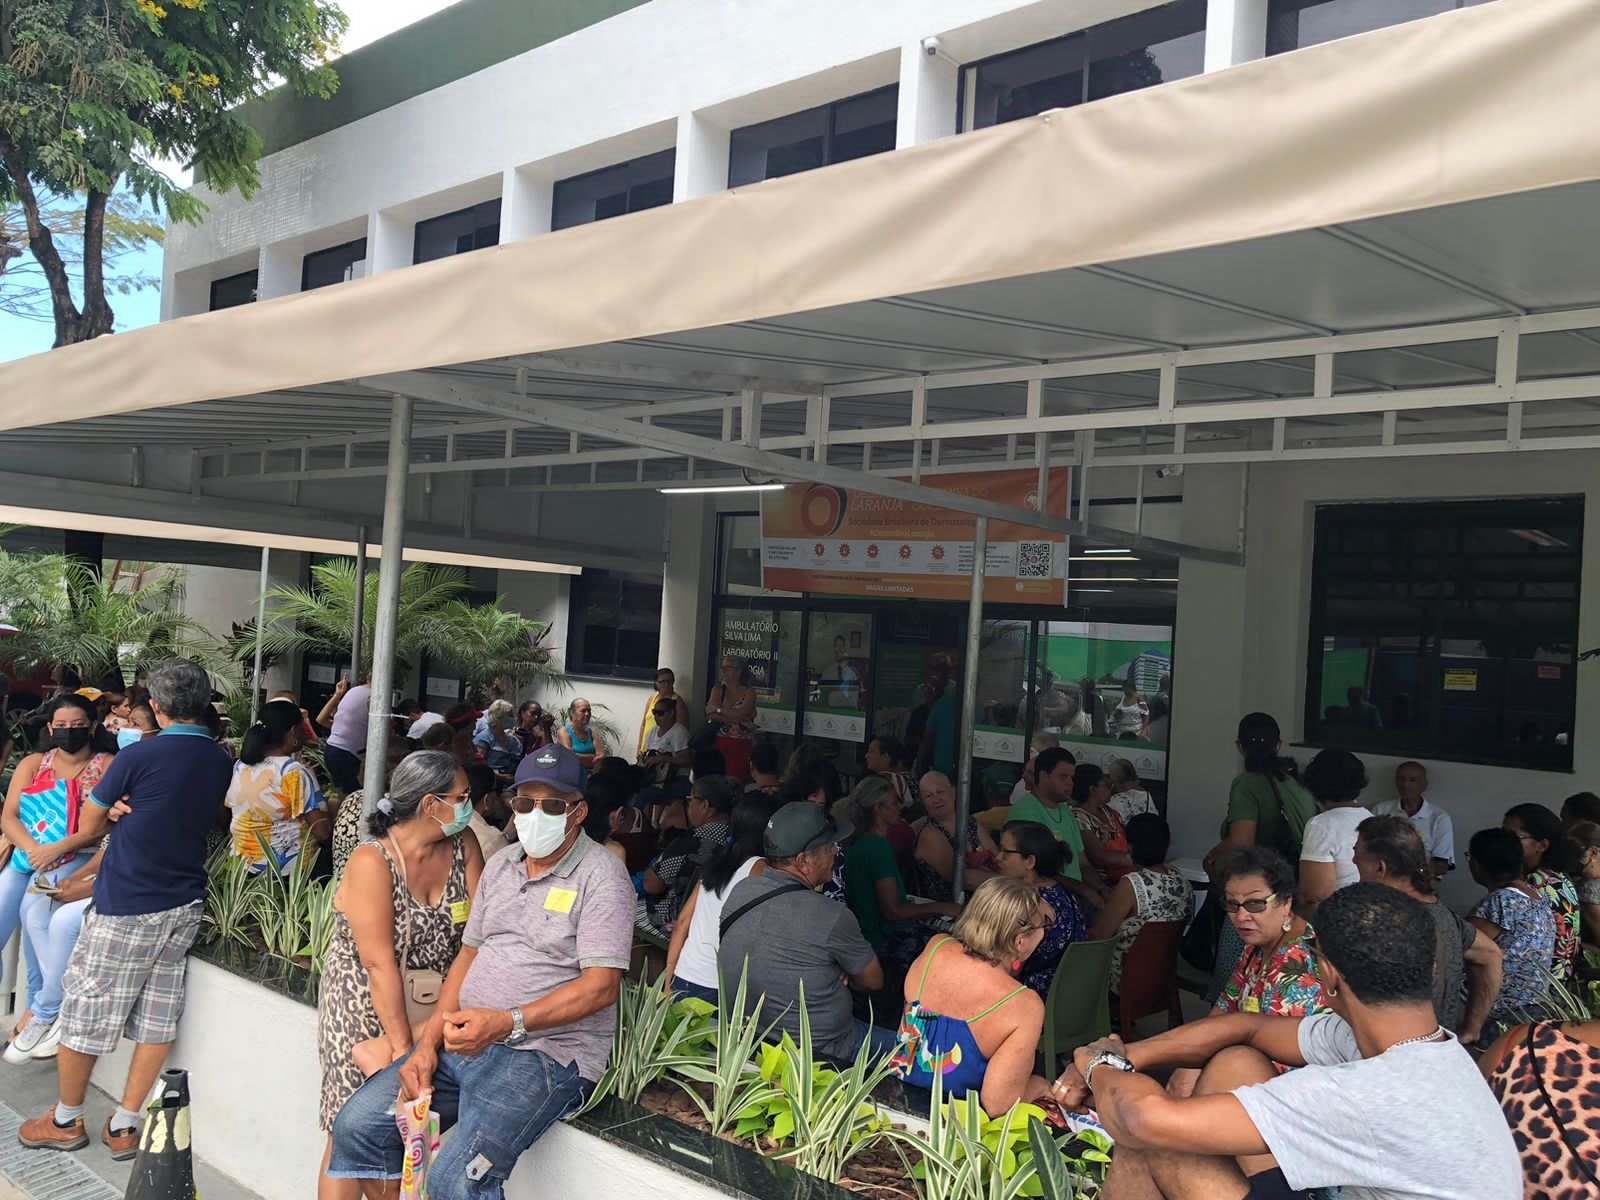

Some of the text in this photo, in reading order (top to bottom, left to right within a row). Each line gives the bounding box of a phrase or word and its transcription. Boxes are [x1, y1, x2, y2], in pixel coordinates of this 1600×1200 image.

[725, 620, 778, 633] AMBULATÓRIO
[724, 631, 761, 641] SILVA LIMA
[722, 647, 771, 660] LABORATÓRIO
